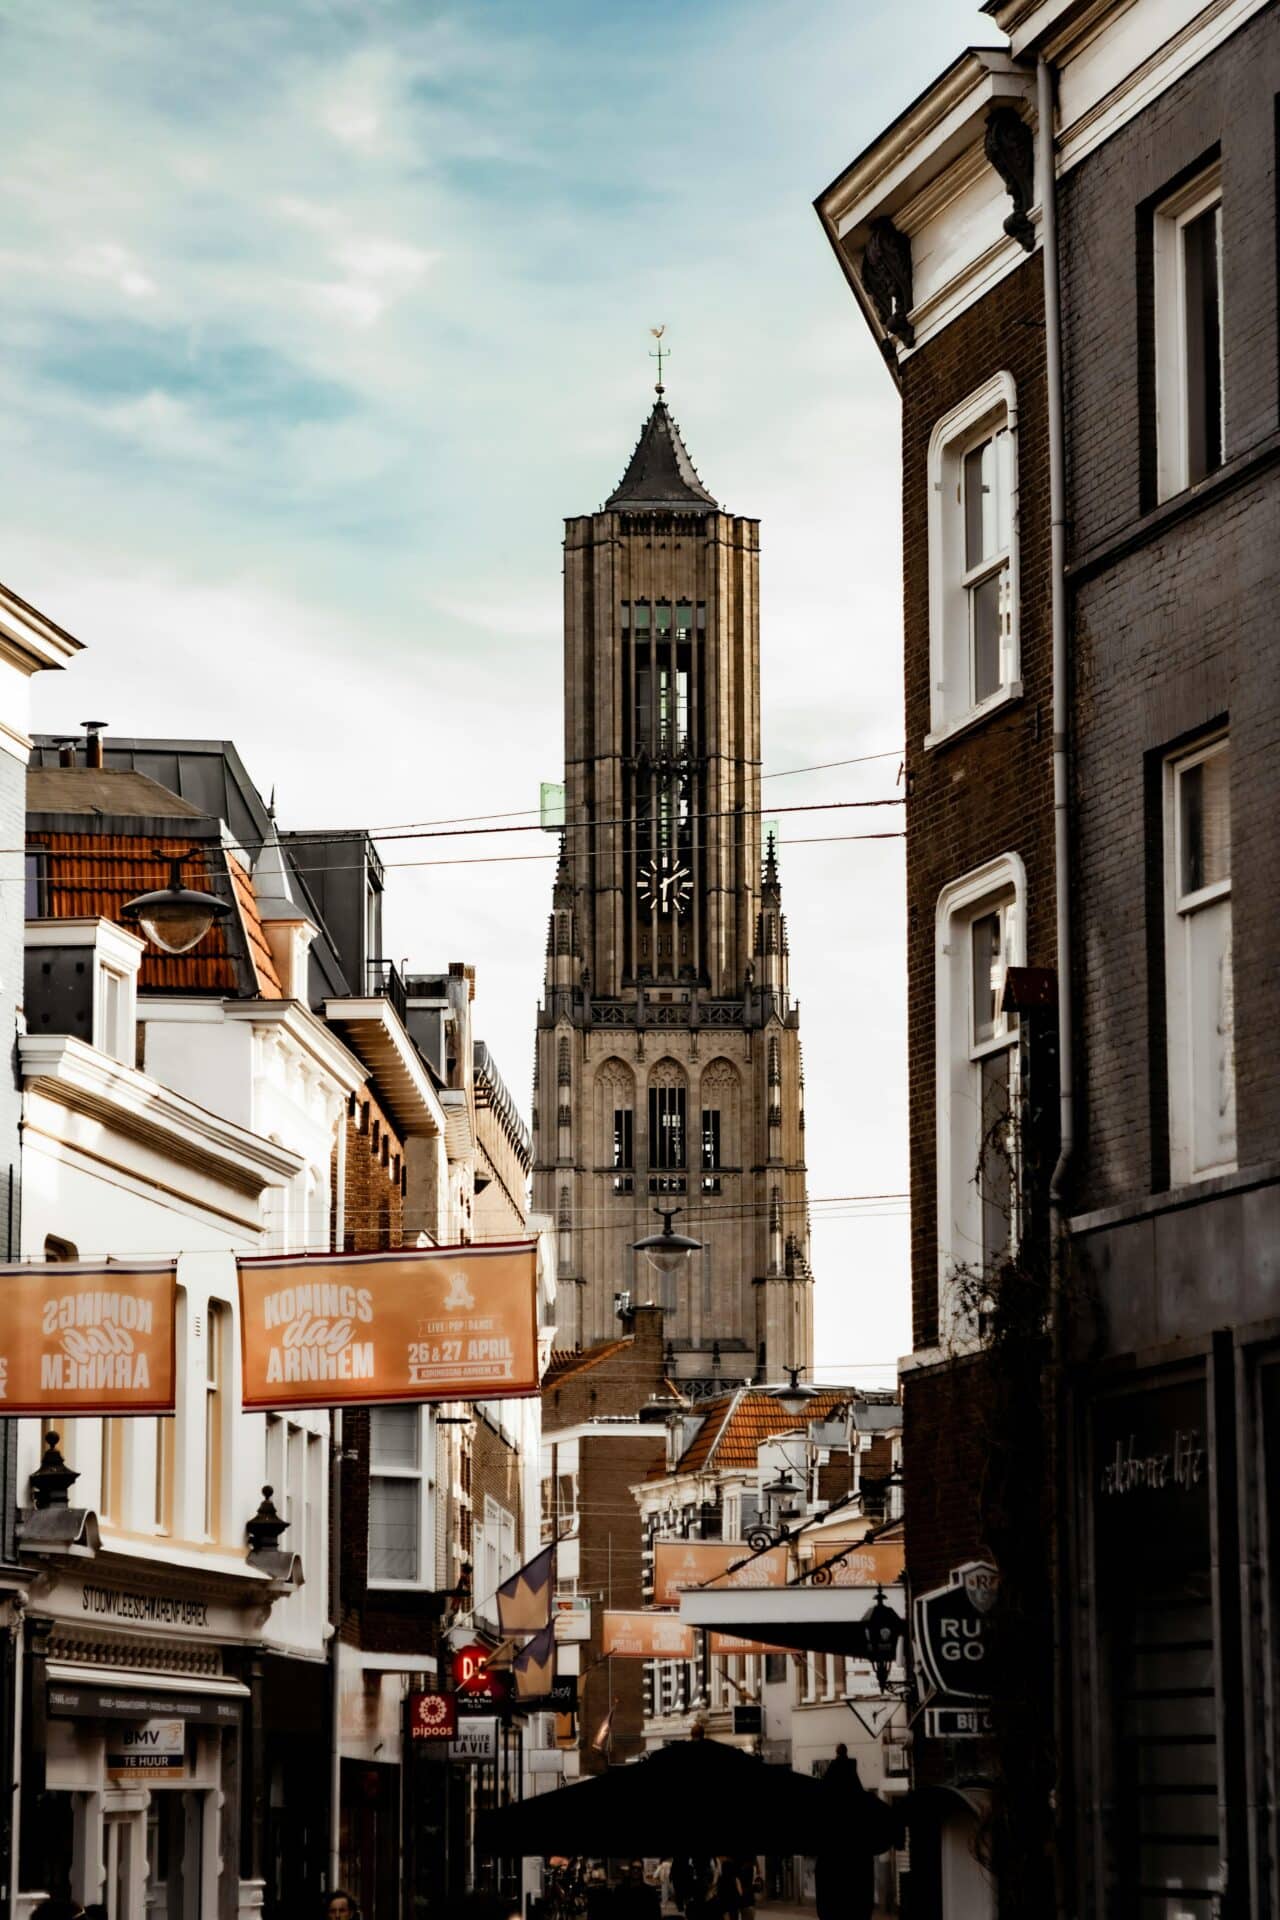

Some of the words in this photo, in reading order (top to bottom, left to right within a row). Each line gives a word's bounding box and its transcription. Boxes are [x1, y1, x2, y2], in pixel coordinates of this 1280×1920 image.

[264, 1283, 374, 1330] KONINGS
[282, 1311, 357, 1353] dag
[407, 1343, 430, 1363] 26
[431, 1346, 441, 1362] &
[442, 1341, 463, 1361] 27
[467, 1337, 514, 1361] APRIL
[266, 1342, 375, 1384] ARNHEM
[940, 1618, 982, 1639] RU
[941, 1640, 985, 1662] GO
[412, 1723, 453, 1738] pipoos
[124, 1756, 137, 1767] TE
[139, 1756, 169, 1767] HUUR
